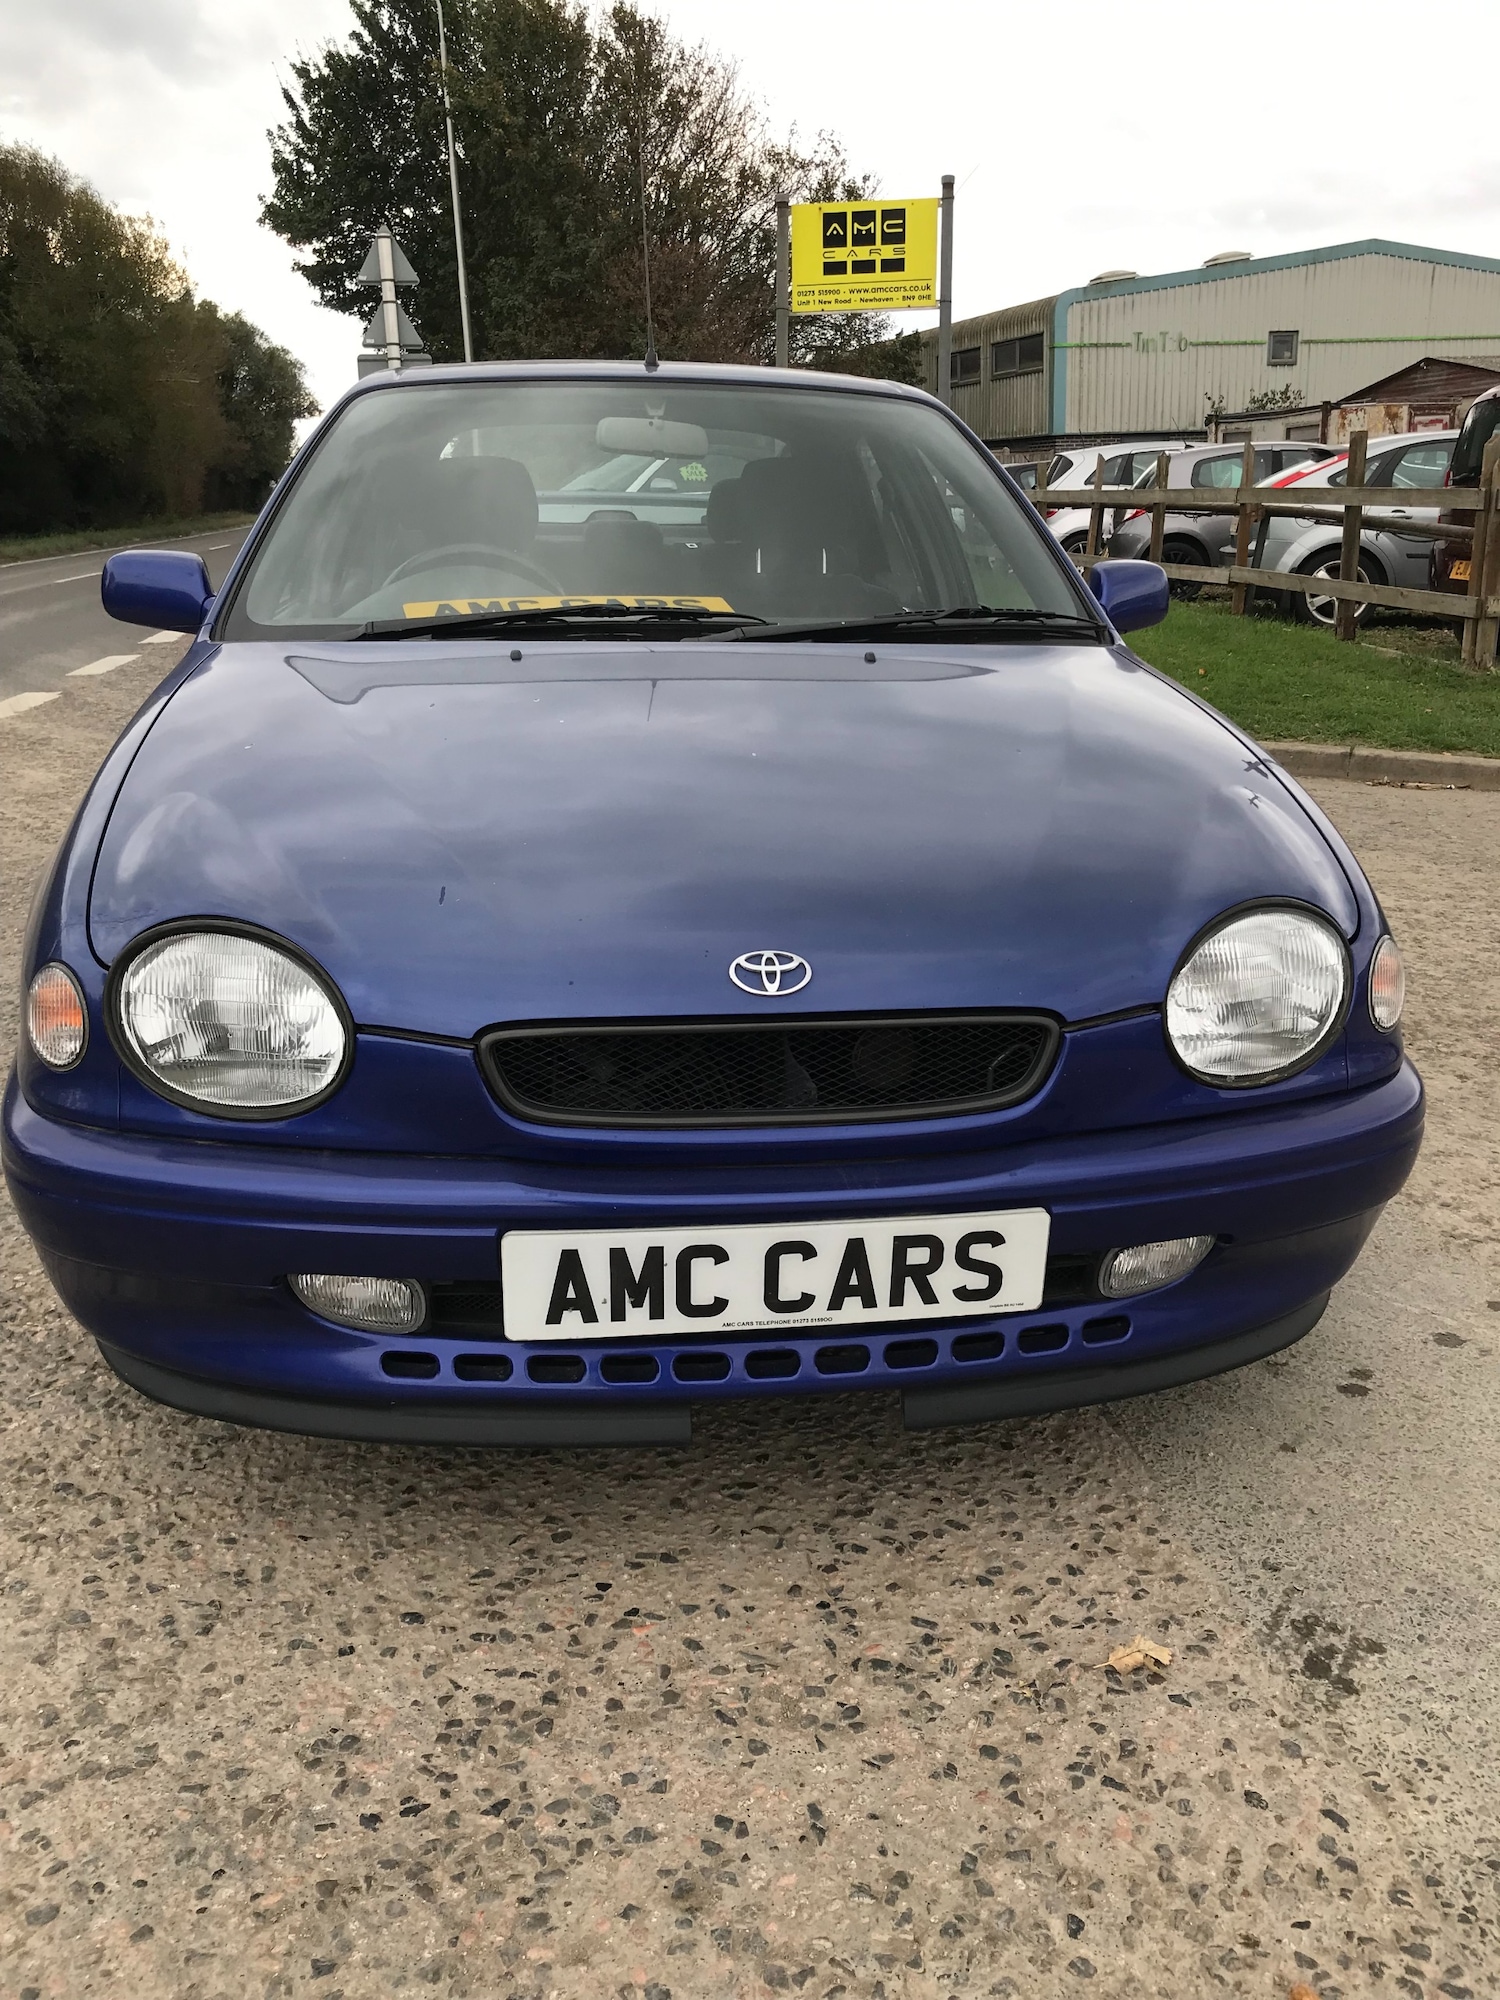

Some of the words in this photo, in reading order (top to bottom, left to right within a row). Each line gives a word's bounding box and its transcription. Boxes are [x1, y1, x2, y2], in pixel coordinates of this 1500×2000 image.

[826, 219, 904, 236] AMC
[822, 247, 906, 259] CARS
[848, 283, 931, 294] www.amccars.co.uk
[545, 1243, 730, 1326] AMC
[763, 1230, 1007, 1315] CARS
